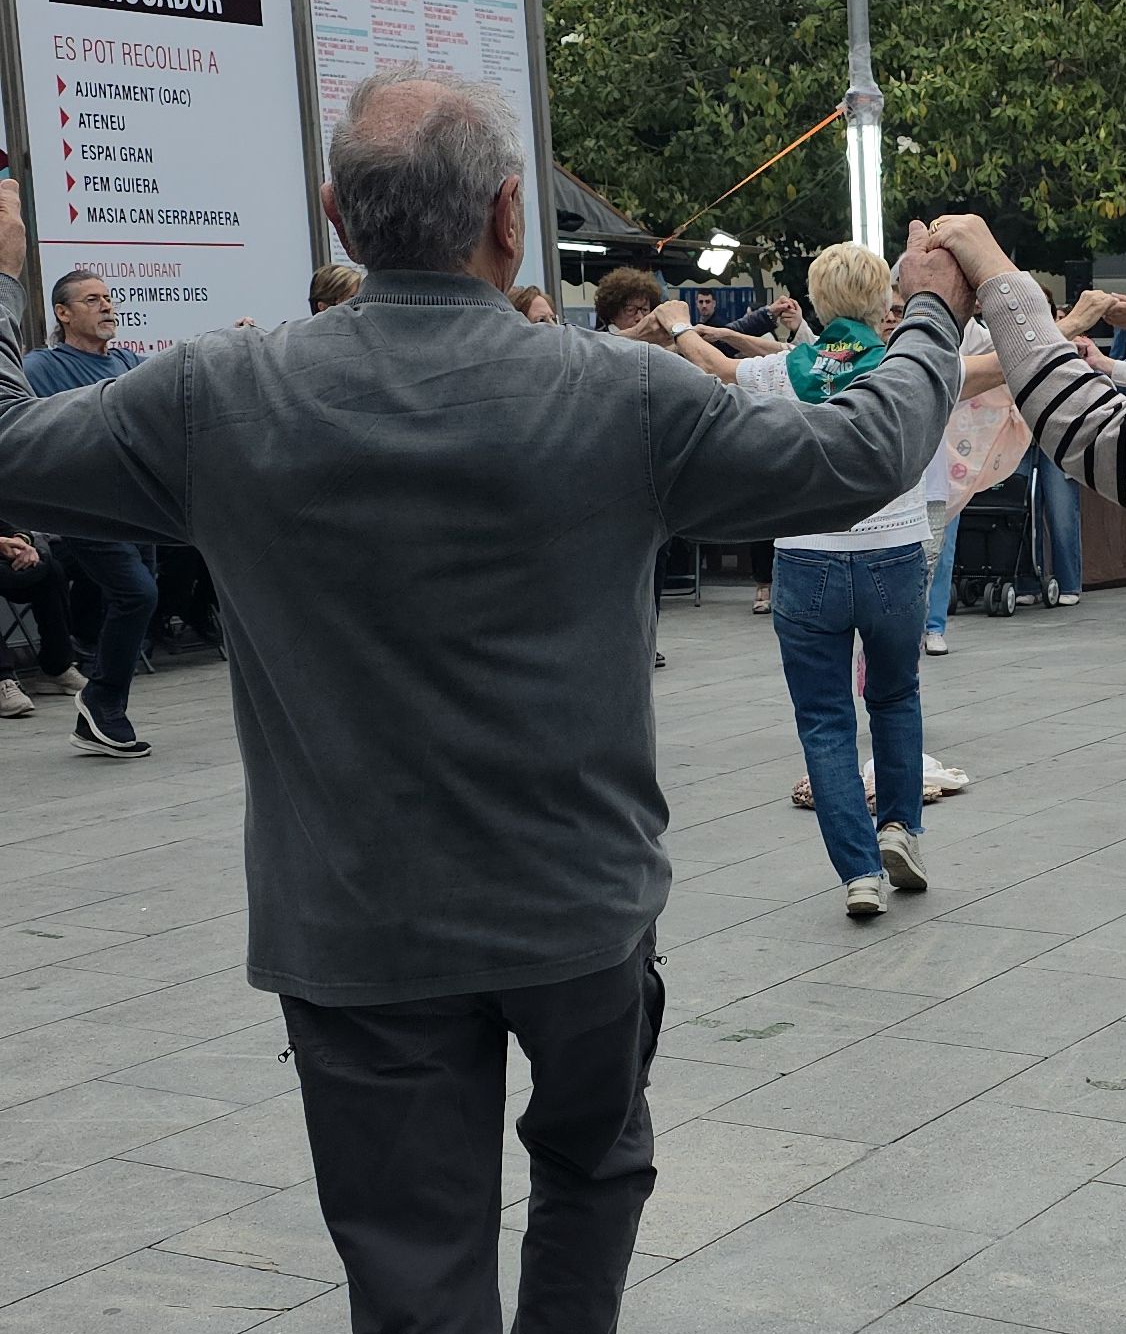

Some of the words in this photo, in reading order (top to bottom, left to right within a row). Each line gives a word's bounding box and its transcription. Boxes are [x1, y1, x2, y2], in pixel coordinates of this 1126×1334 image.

[54, 35, 77, 61] ES
[82, 38, 115, 64] POT
[122, 42, 203, 73] RECOLLIR
[208, 51, 220, 74] A
[75, 80, 155, 103] AJUNTAMENT
[159, 87, 191, 107] (OAC)
[78, 112, 126, 132] ATENEU
[81, 144, 117, 162] ESPAI
[119, 146, 153, 163] GRAN
[84, 175, 111, 192] PEM
[114, 177, 160, 194] GUIERA
[87, 206, 127, 224] MASIA
[130, 208, 154, 224] CAN
[157, 209, 241, 227] SERRAPARERA
[138, 262, 182, 278] DURANT
[129, 287, 180, 302] PRIMERS
[183, 287, 208, 302] DIES
[113, 312, 147, 327] STES:
